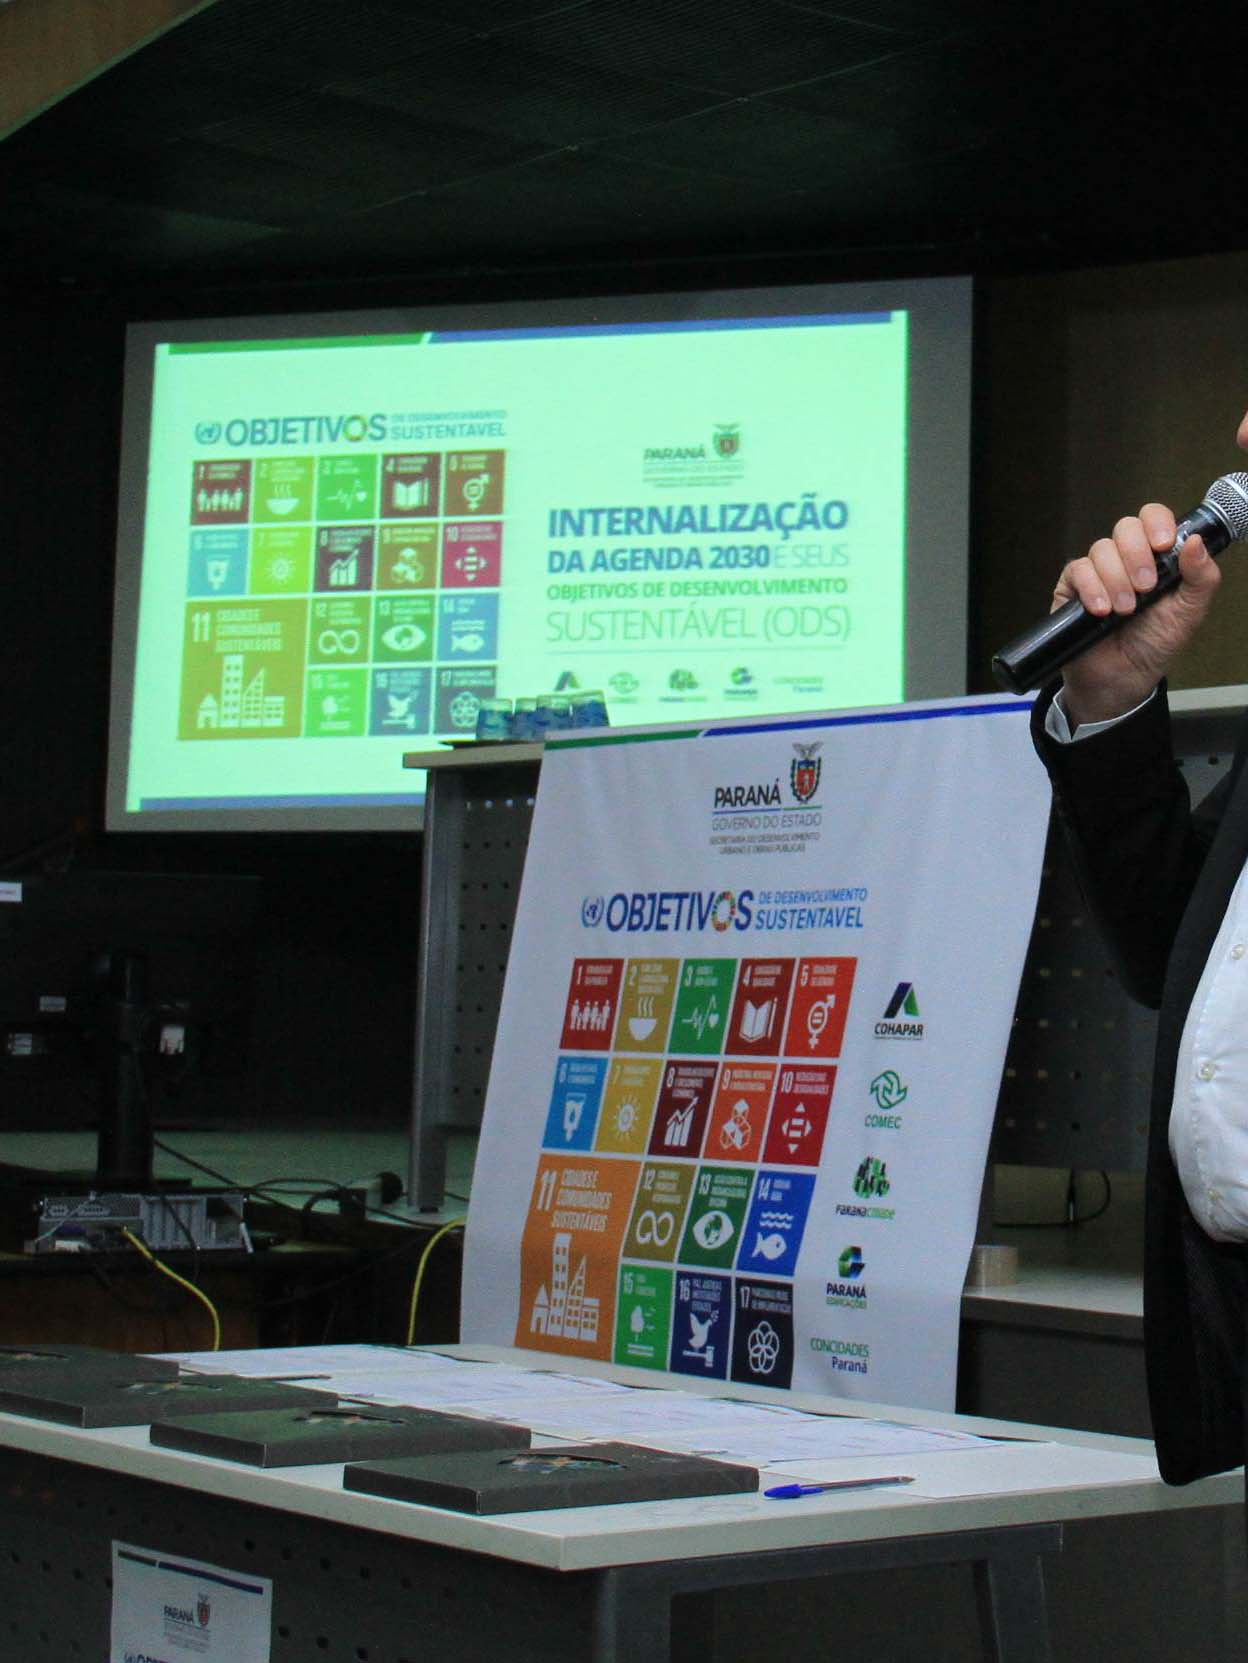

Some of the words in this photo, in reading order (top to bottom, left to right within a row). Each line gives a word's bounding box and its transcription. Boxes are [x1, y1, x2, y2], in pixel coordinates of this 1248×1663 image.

[226, 413, 386, 446] OBJETIVOS
[549, 492, 849, 540] INTERNALIZAÇÃO
[548, 550, 585, 573] DA
[590, 547, 703, 572] AGENDA
[709, 544, 770, 569] 2030
[774, 547, 786, 568] E
[791, 544, 849, 568] SEUS
[547, 582, 638, 603] OBJETIVOS
[643, 582, 665, 597] DE
[670, 578, 847, 596] DESENVOLVIMENTO
[192, 611, 211, 642] 11
[546, 602, 756, 642] SUSTENTÁVEL
[763, 605, 850, 641] (ODS)
[714, 778, 782, 808] PARANÁ
[712, 816, 760, 831] GOVERNO
[763, 816, 778, 828] DO
[782, 813, 822, 828] ESTADO
[759, 891, 772, 904] DE
[774, 888, 868, 904] DESENVOLVIMENTO
[606, 890, 754, 932] OBJETIVOS
[756, 907, 864, 930] SUSTENTAVEL
[874, 1023, 924, 1036] COHAPAR
[781, 1071, 793, 1093] 10
[865, 1115, 902, 1129] COMEC
[538, 1171, 557, 1211] 11
[827, 1282, 866, 1298] PARANÁ
[810, 1338, 869, 1357] CONCIDADES
[832, 1356, 867, 1373] Paraná
